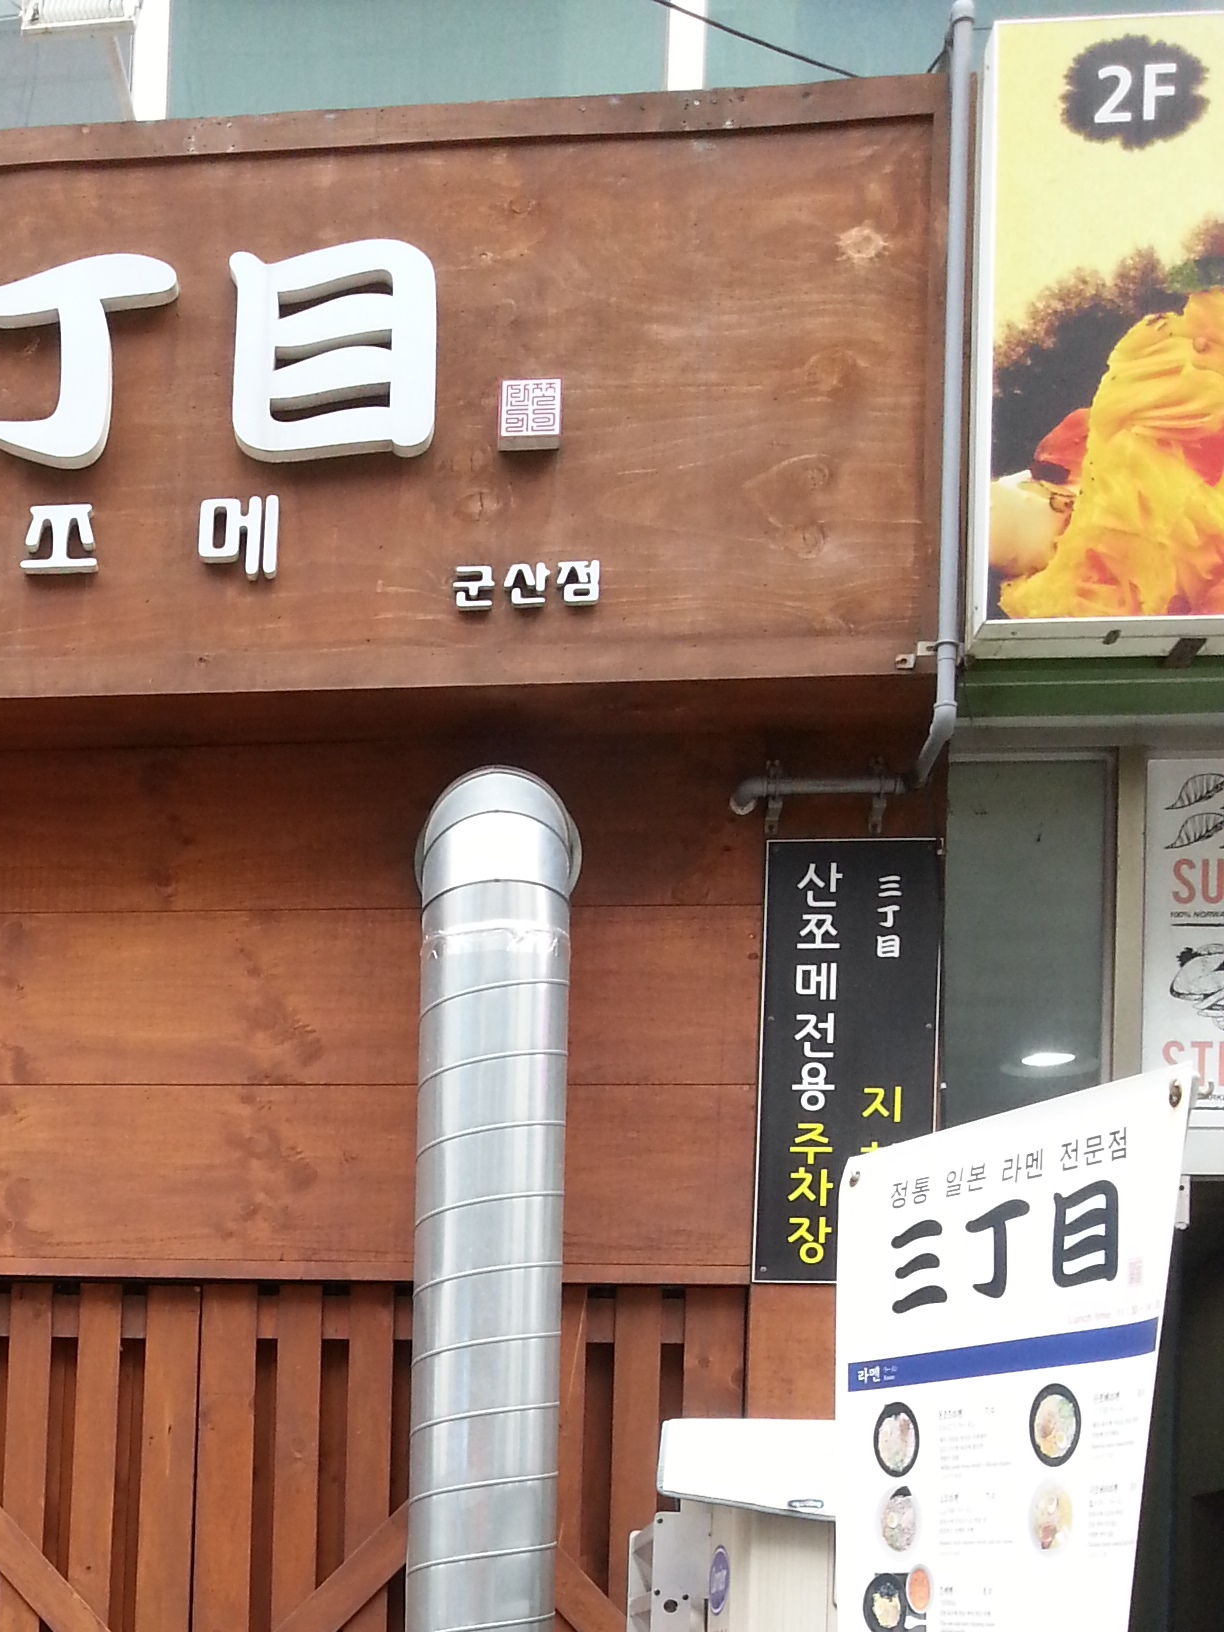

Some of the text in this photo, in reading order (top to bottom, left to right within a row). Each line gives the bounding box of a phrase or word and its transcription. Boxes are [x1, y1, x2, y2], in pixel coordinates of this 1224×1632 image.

[1094, 62, 1178, 124] 2F
[453, 558, 602, 612] 군산점
[889, 1126, 1128, 1209] 정통 일본 라멘 전문점
[857, 1365, 881, 1385] 라멘
